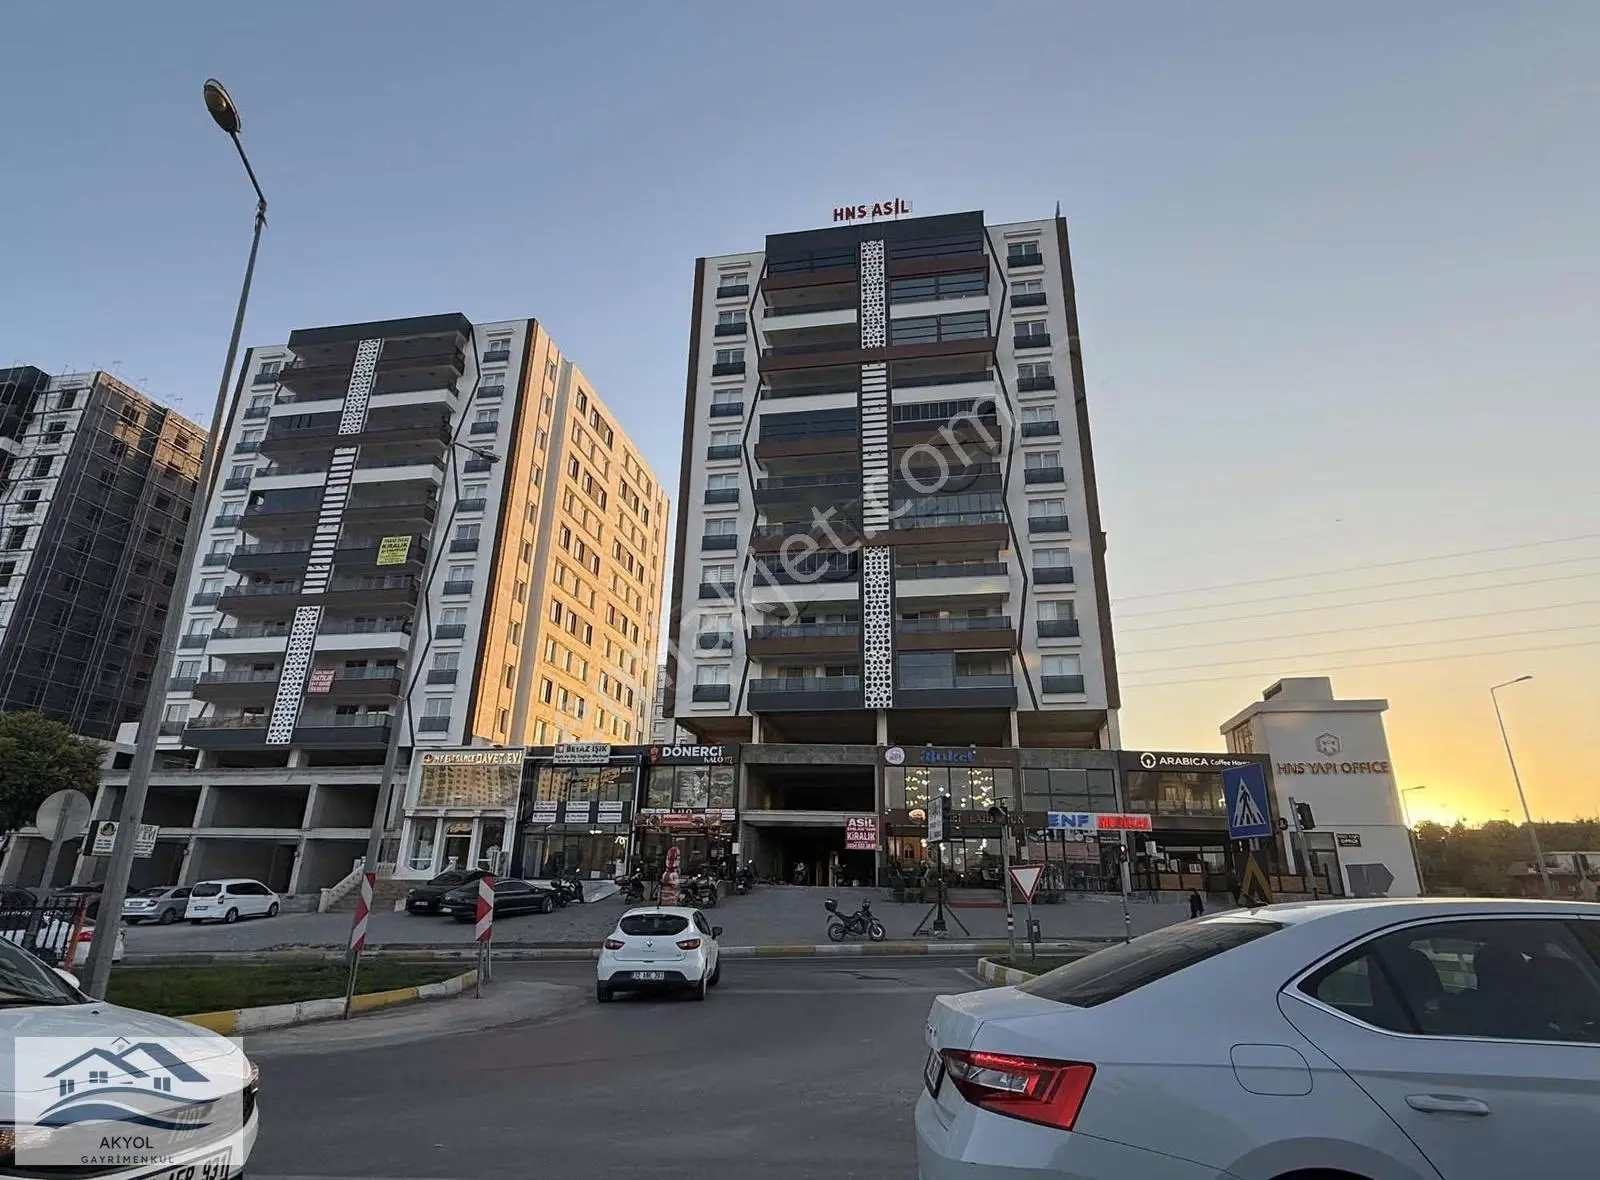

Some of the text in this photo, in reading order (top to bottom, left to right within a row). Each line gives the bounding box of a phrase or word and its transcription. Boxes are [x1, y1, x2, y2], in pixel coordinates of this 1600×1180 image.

[833, 205, 867, 222] HNS
[1159, 756, 1209, 766] ARABICA
[1277, 762, 1305, 775] HNS
[1341, 760, 1389, 774] OFFICE
[848, 817, 875, 827] ASİL
